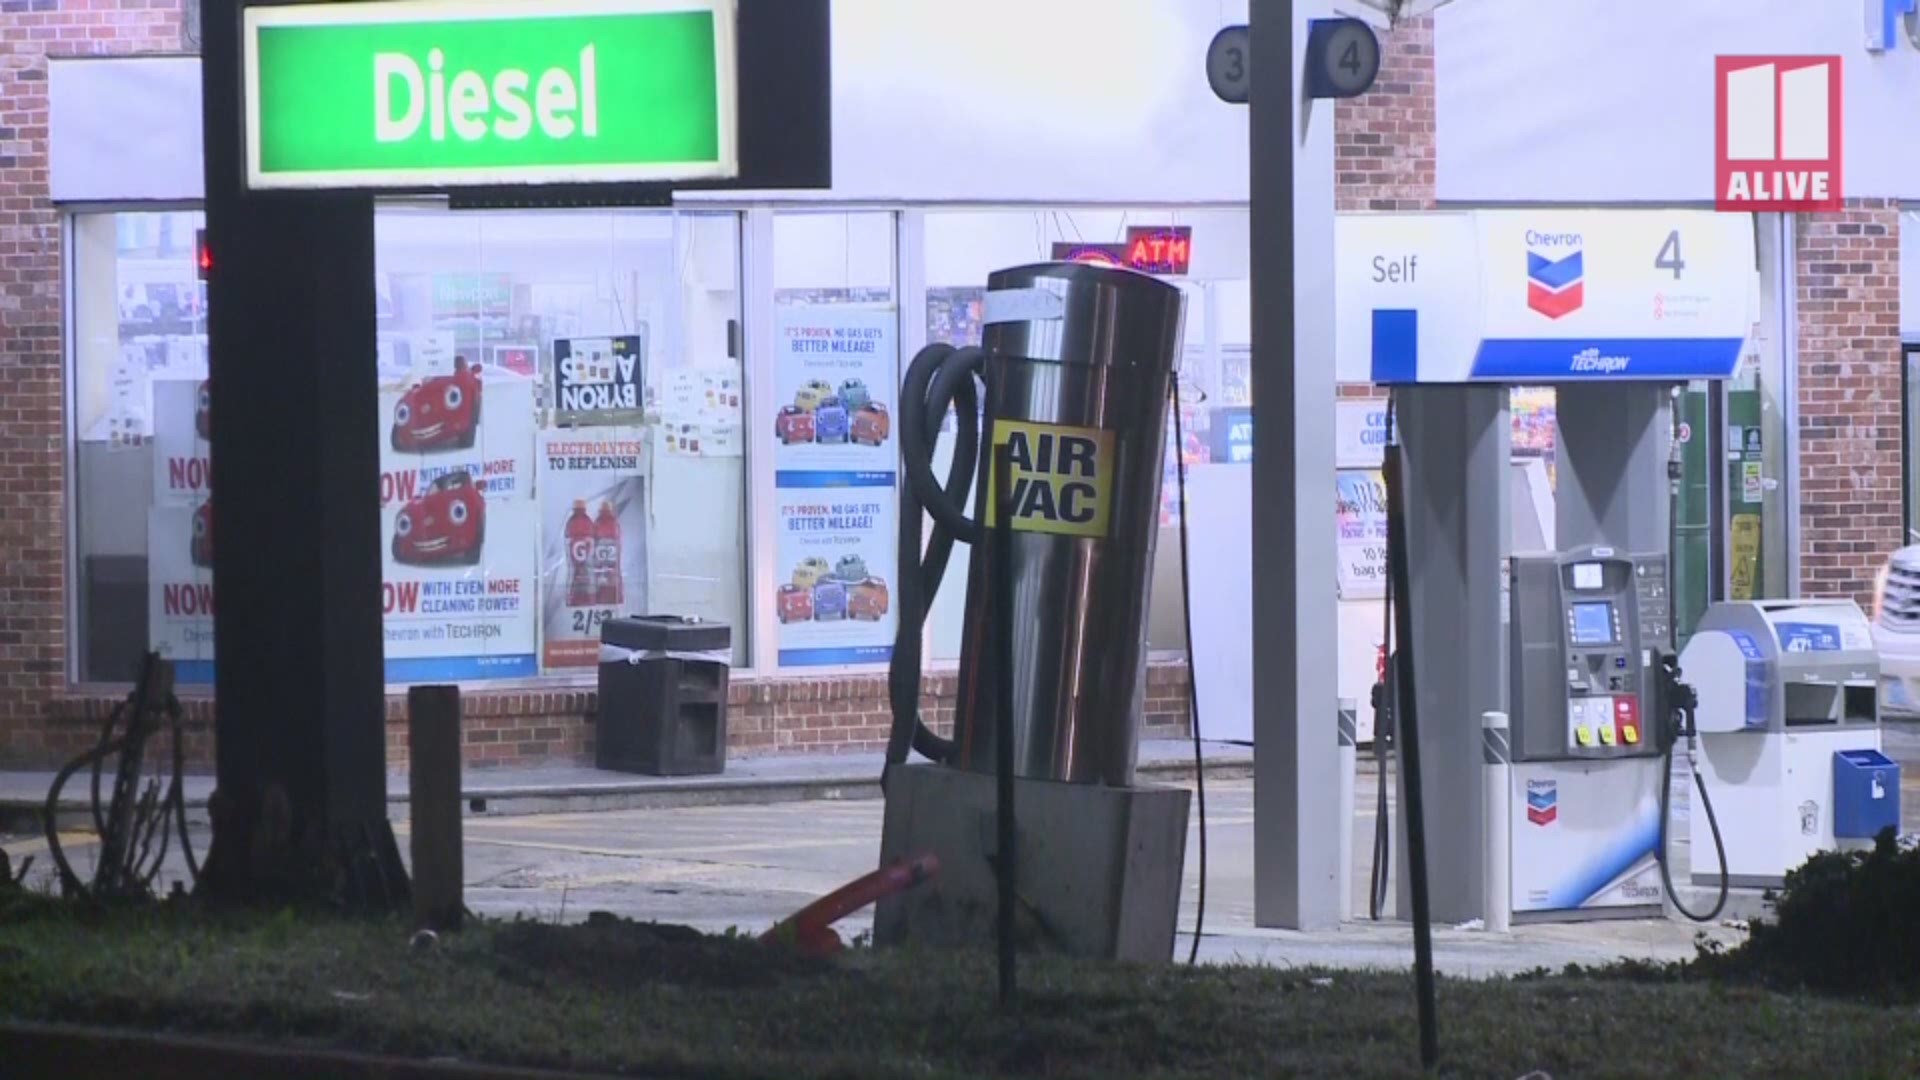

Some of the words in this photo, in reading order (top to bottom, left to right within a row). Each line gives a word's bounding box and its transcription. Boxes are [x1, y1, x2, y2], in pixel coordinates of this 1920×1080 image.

[1225, 47, 1244, 82] 3
[1338, 40, 1361, 75] 4
[374, 43, 597, 142] Diesel
[1132, 238, 1186, 263] ATM
[1525, 229, 1583, 247] Chevron
[1654, 230, 1685, 280] 4
[1372, 255, 1417, 284] Self
[791, 340, 829, 353] BETTER
[561, 354, 637, 386] AS
[1569, 355, 1630, 373] TECHRON
[562, 384, 636, 410] BYRON
[546, 442, 641, 455] ELECTROLYTES
[1003, 431, 1097, 477] AIR
[549, 457, 565, 470] TO
[568, 456, 637, 470] REPLENISH
[381, 470, 416, 502] OW
[483, 459, 515, 475] MORE
[788, 517, 825, 531] BETTER
[828, 515, 873, 529] MILEAGE!
[384, 581, 419, 613] OW
[422, 580, 450, 596] WITH
[455, 579, 485, 595] EVEN
[488, 579, 520, 593] MORE
[421, 599, 475, 613] CLEANING
[478, 597, 519, 611] POWER!
[384, 626, 420, 641] hevron
[423, 623, 445, 639] with
[446, 623, 501, 640] TECHRON
